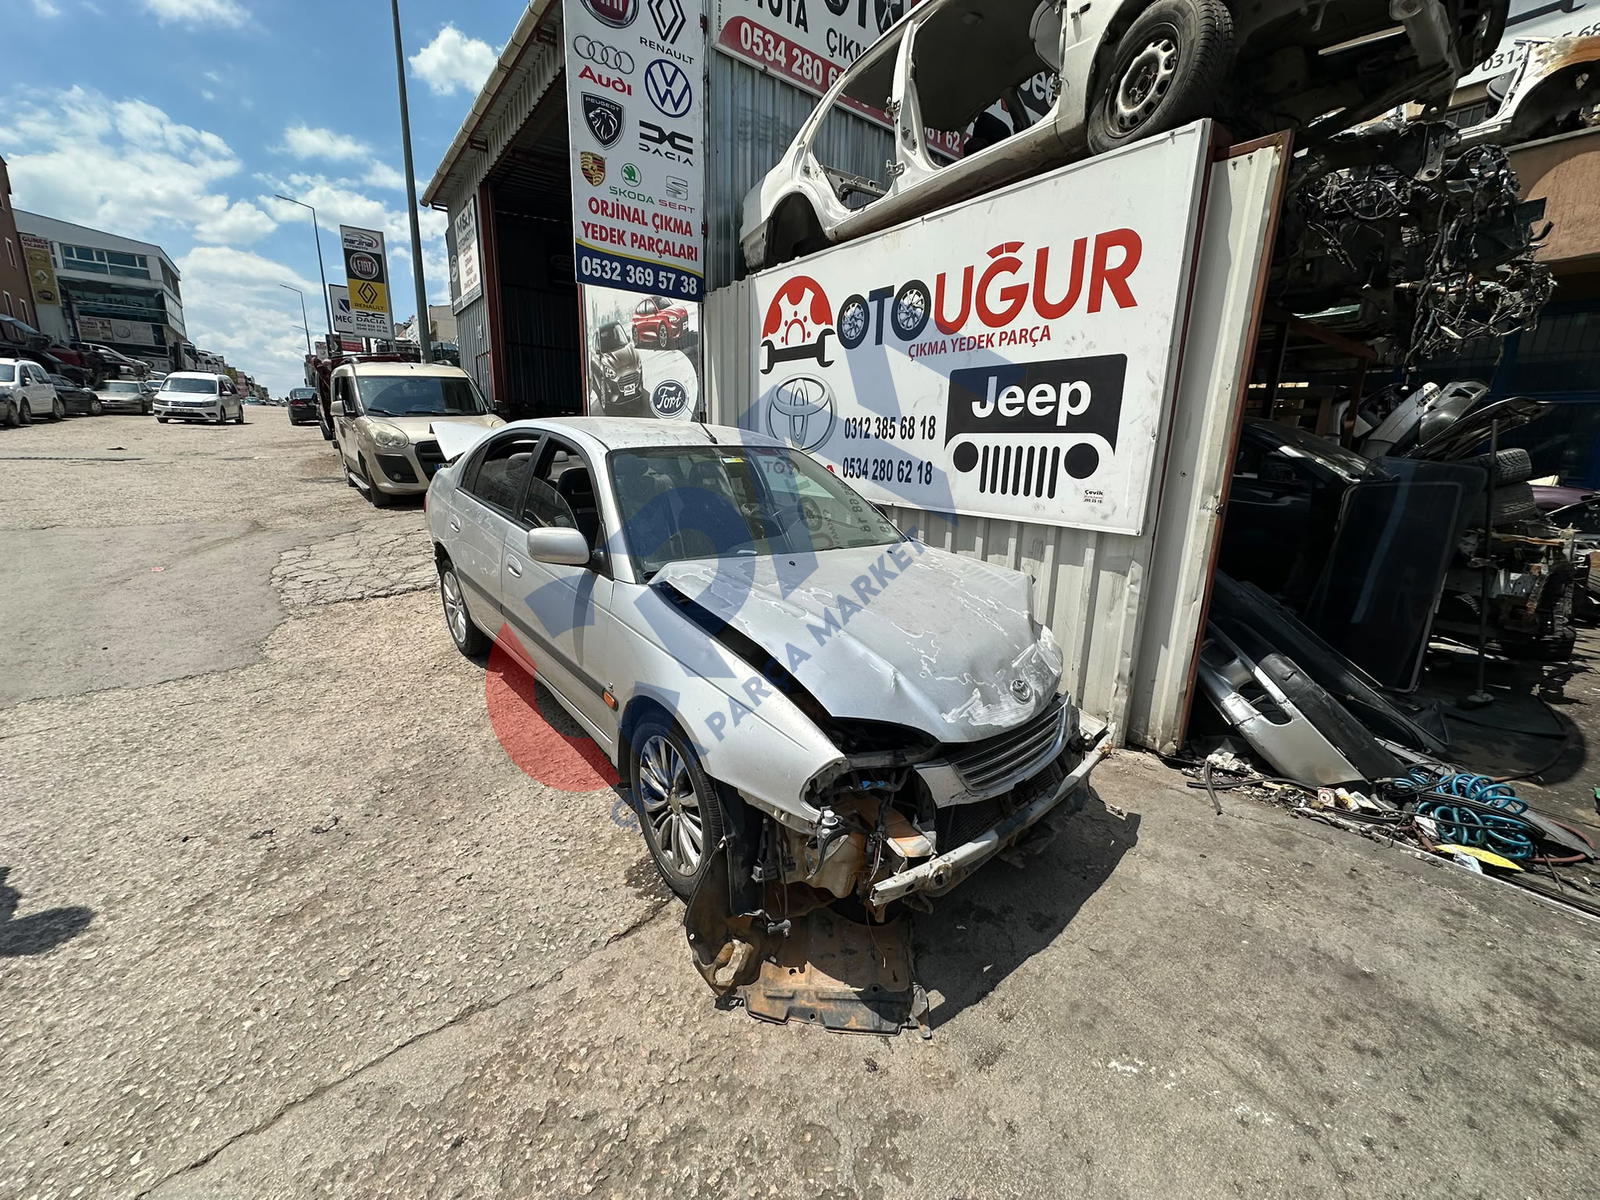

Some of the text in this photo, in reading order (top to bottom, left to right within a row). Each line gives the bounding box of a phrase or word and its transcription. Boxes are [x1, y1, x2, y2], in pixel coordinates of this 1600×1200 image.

[639, 35, 695, 65] RENAULT
[740, 21, 787, 68] 0534
[791, 47, 823, 86] 280
[578, 64, 632, 96] Audi
[584, 96, 621, 112] PEUGEOT
[638, 142, 694, 167] DACIA
[587, 196, 693, 238] ORJİNAL ÇIKMA
[658, 199, 696, 214] SEAT
[581, 220, 698, 262] YEDEK PARÇALARI
[357, 259, 372, 273] FIAT
[580, 255, 697, 295] 0532 369 57 38
[354, 303, 385, 311] RENAULT
[356, 317, 386, 325] DACIA
[907, 324, 1052, 362] ÇIKMA YEDEK PARÇA
[971, 375, 1093, 428] Jeep
[844, 414, 937, 441] 0312 385 68 18
[842, 456, 933, 486] 0534 280 62 18
